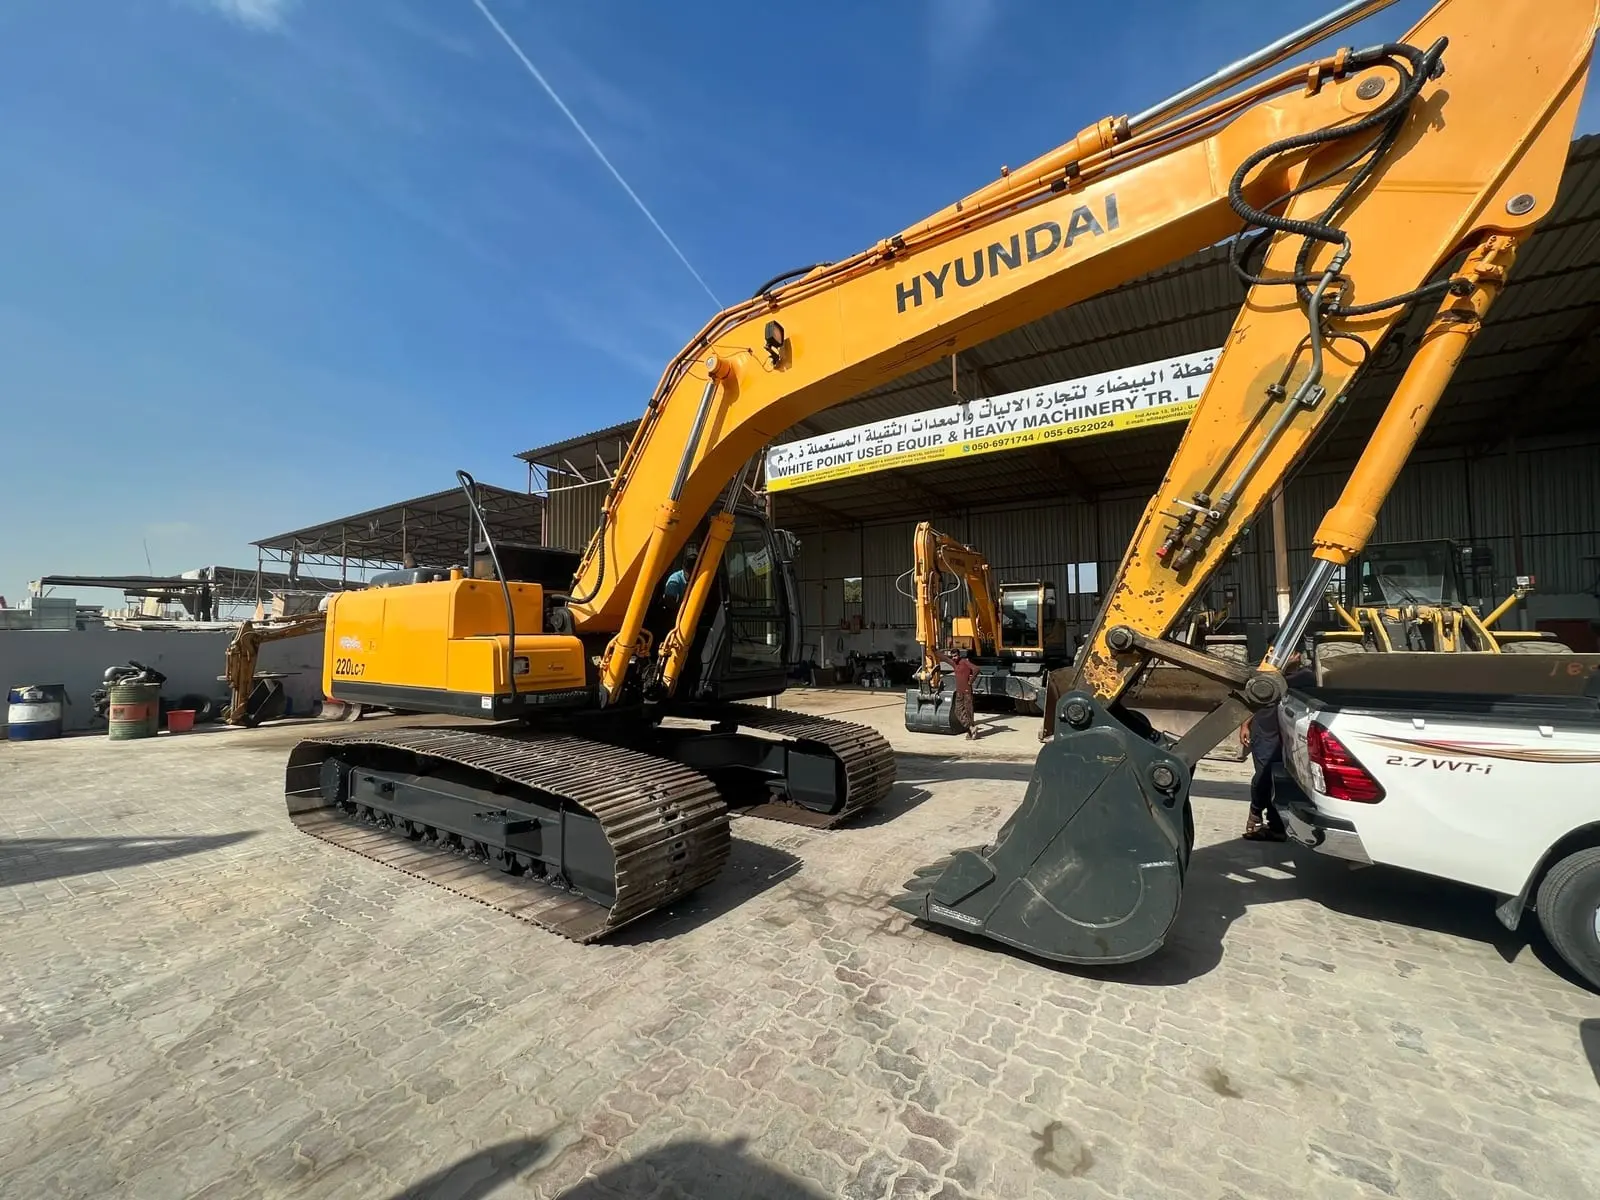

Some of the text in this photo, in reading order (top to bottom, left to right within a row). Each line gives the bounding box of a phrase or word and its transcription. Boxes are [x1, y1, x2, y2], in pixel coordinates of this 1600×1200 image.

[896, 193, 1119, 314] HYUNDAI
[1170, 356, 1214, 380] قطة
[1095, 370, 1164, 397] البيضاء
[1036, 385, 1087, 410] لتجارة
[778, 461, 813, 477] WHITE
[817, 451, 854, 469] POINT
[857, 443, 893, 459] USED
[897, 433, 943, 452] EQUIP.
[948, 430, 958, 443] &
[963, 418, 1018, 440] HEAVY
[1023, 395, 1138, 429] MACHINERY
[1144, 389, 1179, 406] TR.
[1186, 385, 1200, 399] L
[865, 421, 907, 445] الثقيلة
[911, 410, 974, 433] والمعدات
[808, 434, 861, 455] المستعملة
[972, 433, 1034, 451] 050-6971744
[1043, 419, 1115, 439] 055-6522024
[1386, 755, 1493, 775] 2.7 VVT-i
